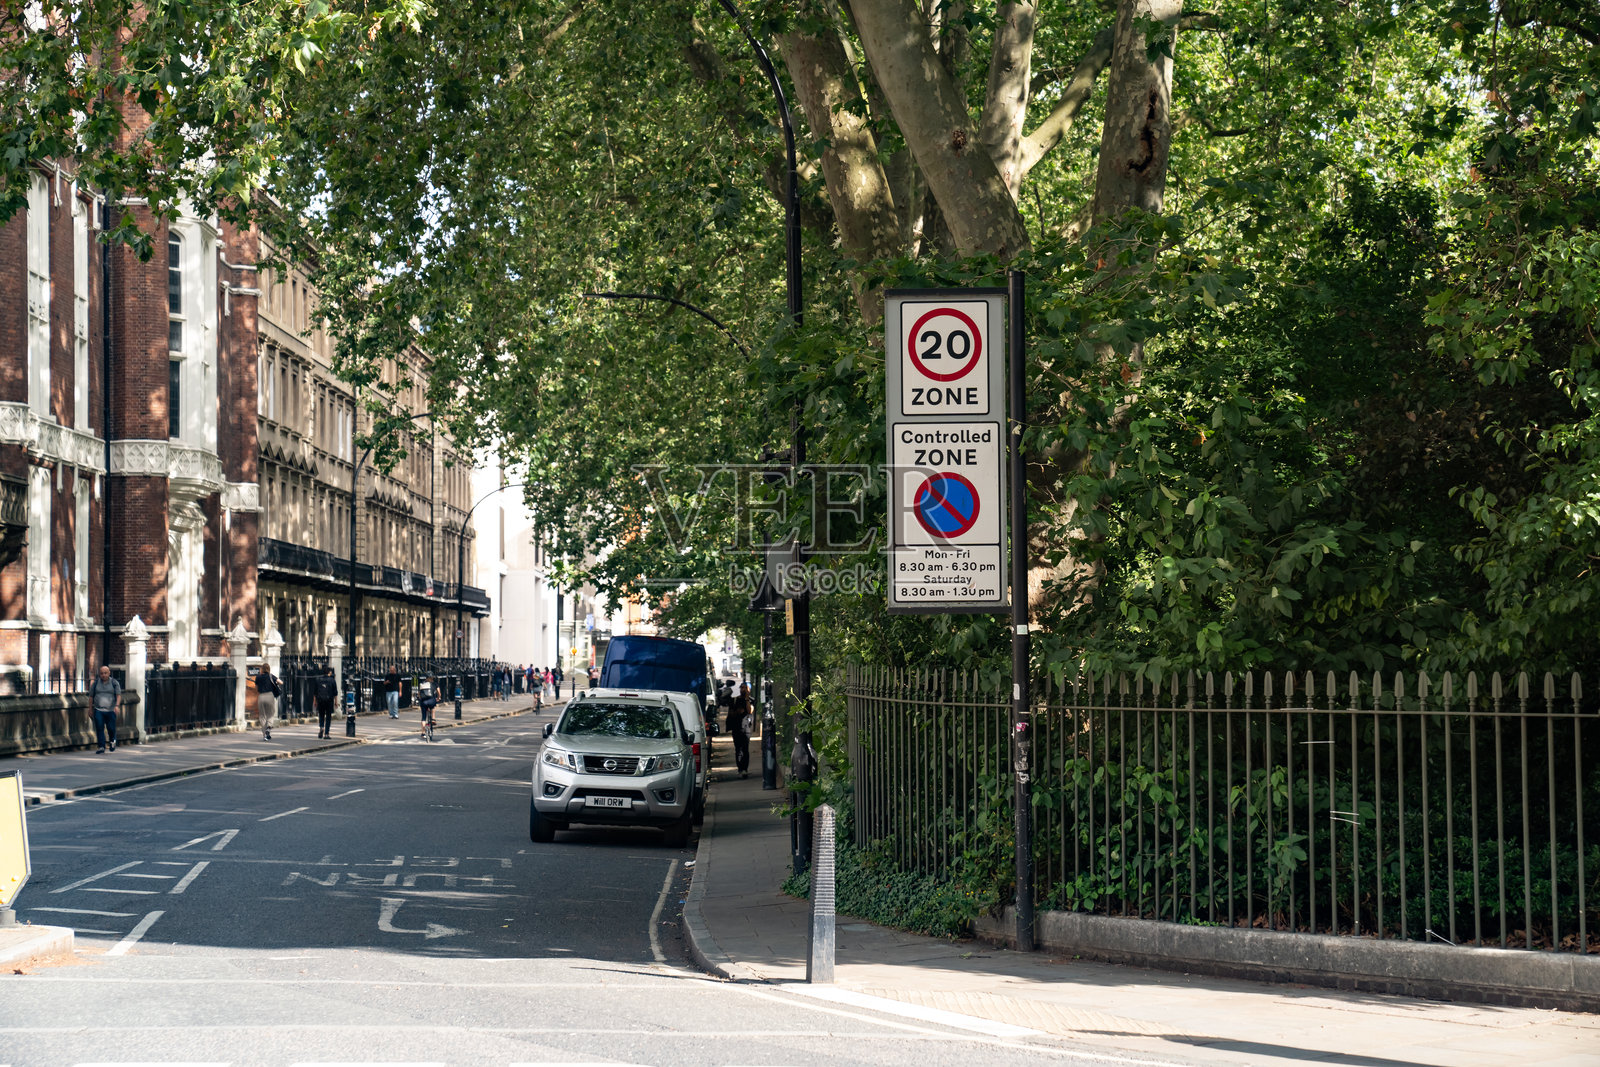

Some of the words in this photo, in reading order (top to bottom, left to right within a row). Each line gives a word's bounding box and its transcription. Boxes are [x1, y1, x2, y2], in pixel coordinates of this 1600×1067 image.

[920, 330, 971, 360] 20
[912, 387, 979, 406] ZONE
[901, 429, 992, 444] Controlled
[914, 449, 978, 466] ZONE
[925, 550, 948, 559] Mon
[956, 550, 970, 559] Fri
[899, 562, 925, 572] 8.30
[927, 564, 943, 572] am
[951, 562, 977, 572] 6.30
[979, 563, 996, 573] pm
[923, 575, 972, 585] Saturday
[901, 587, 927, 597] 8.30
[929, 589, 945, 597] am
[953, 587, 977, 597] 1.30
[978, 588, 995, 598] pm
[280, 872, 516, 888] TURN
